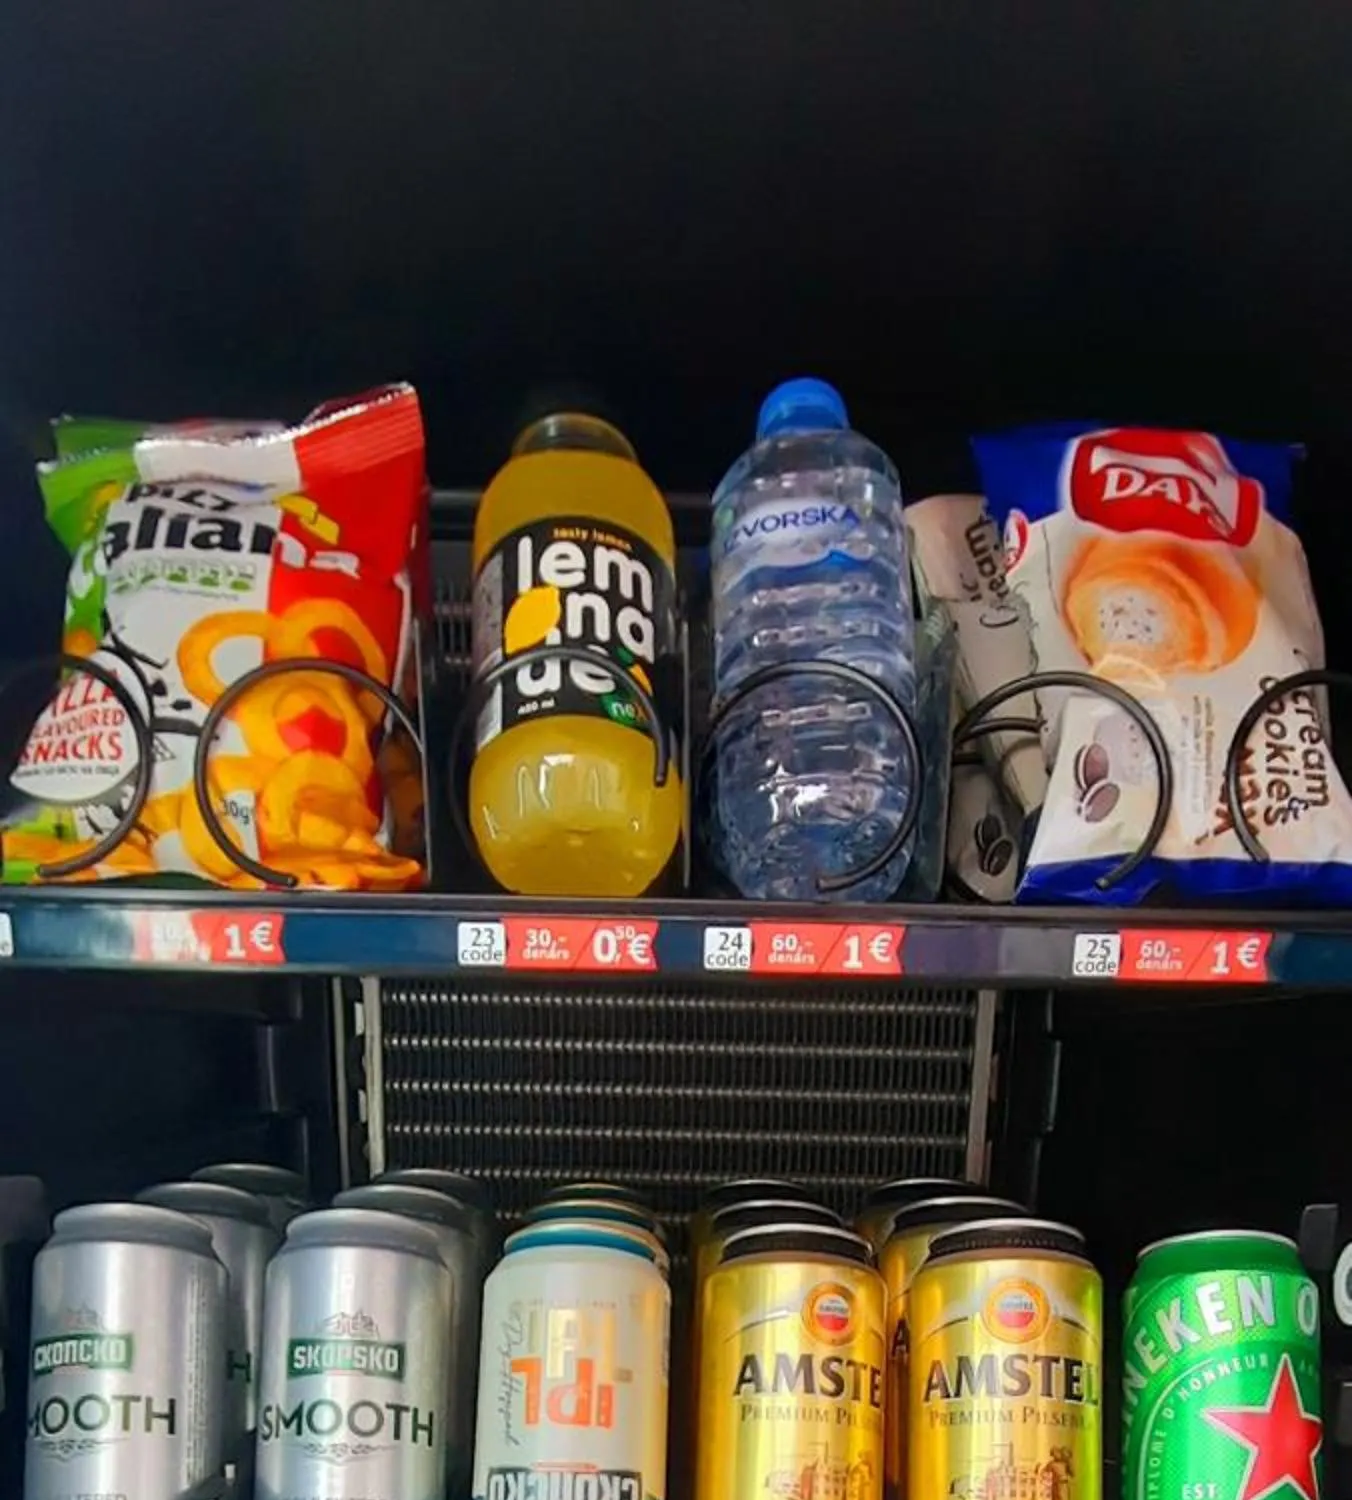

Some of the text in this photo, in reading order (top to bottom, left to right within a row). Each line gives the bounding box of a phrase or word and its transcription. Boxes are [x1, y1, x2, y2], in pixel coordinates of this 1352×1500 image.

[1294, 689, 1332, 803] cream
[470, 928, 495, 947] 23
[718, 932, 744, 951] 24
[461, 947, 504, 963] code
[1086, 939, 1112, 958] 25
[706, 950, 749, 968] code
[1075, 956, 1117, 974] code
[923, 1354, 1099, 1407] AMSTEL
[259, 1398, 435, 1447] SMOOTH
